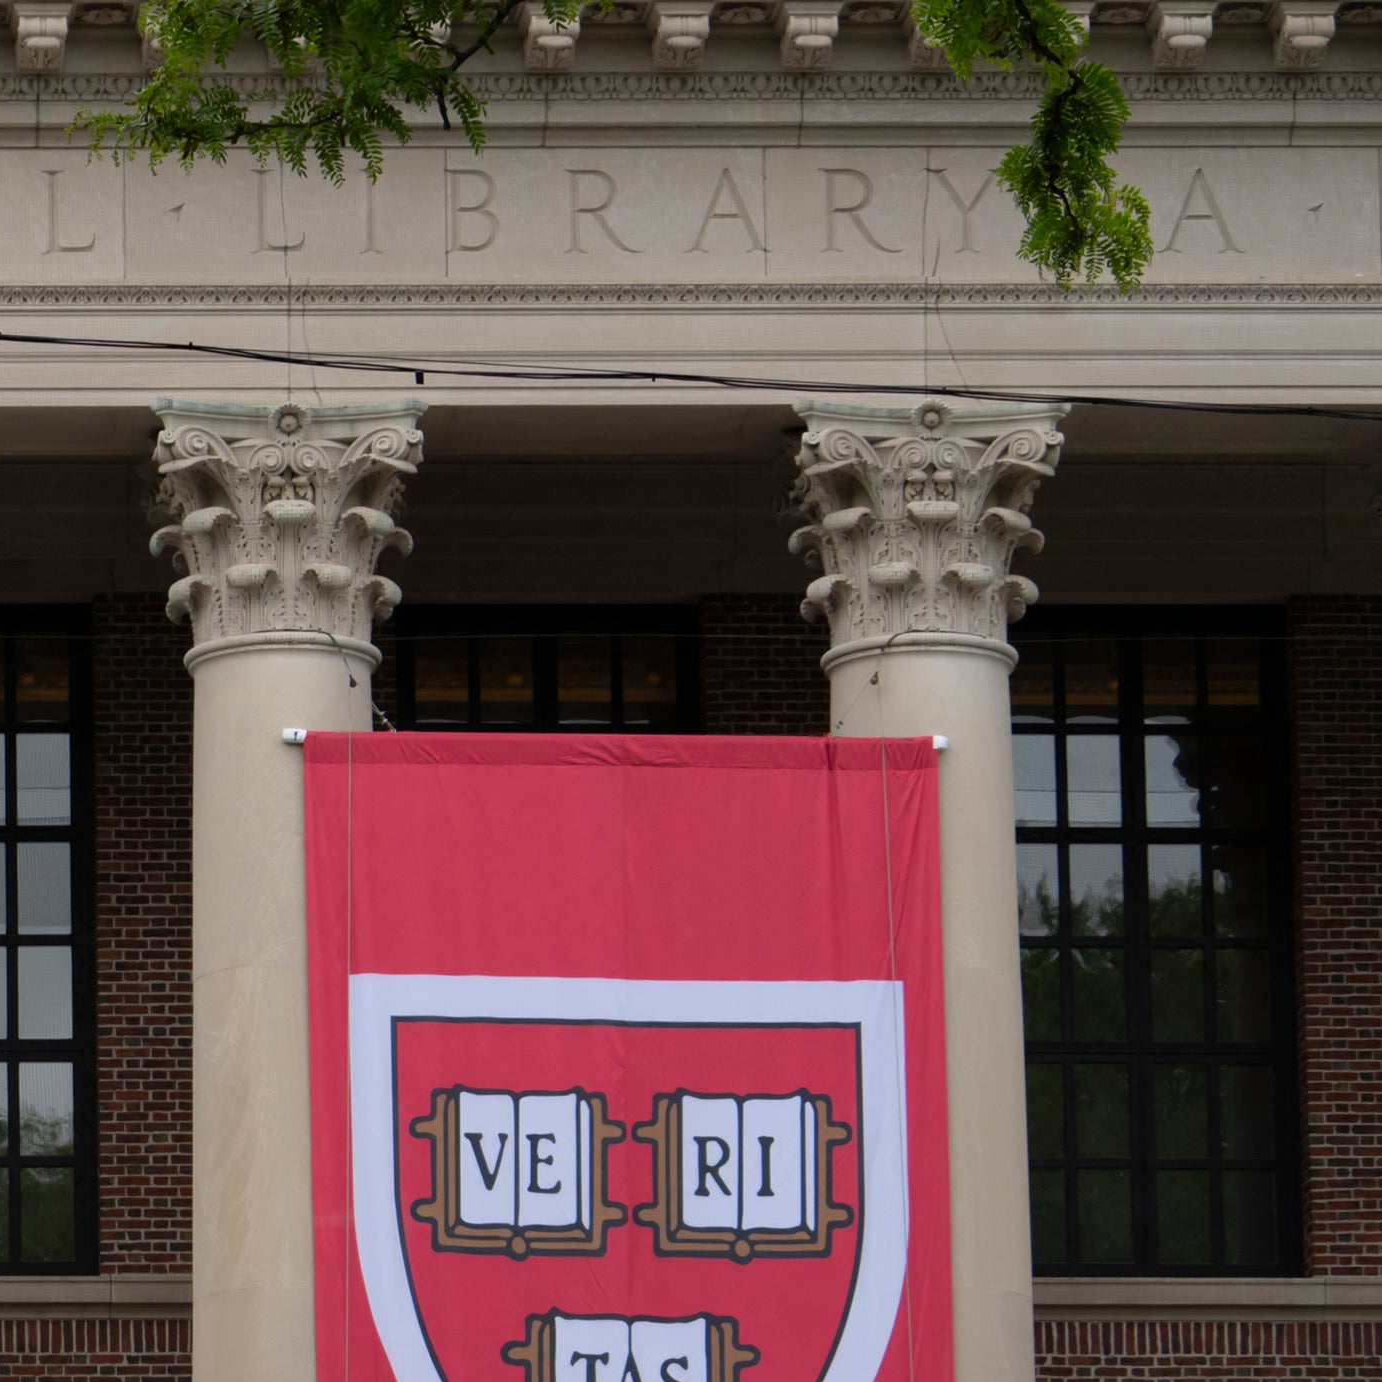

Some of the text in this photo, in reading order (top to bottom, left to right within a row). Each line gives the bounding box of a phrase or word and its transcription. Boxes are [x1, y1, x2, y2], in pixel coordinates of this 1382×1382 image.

[248, 167, 1003, 255] LIBRARY
[463, 1132, 776, 1198] VE RI
